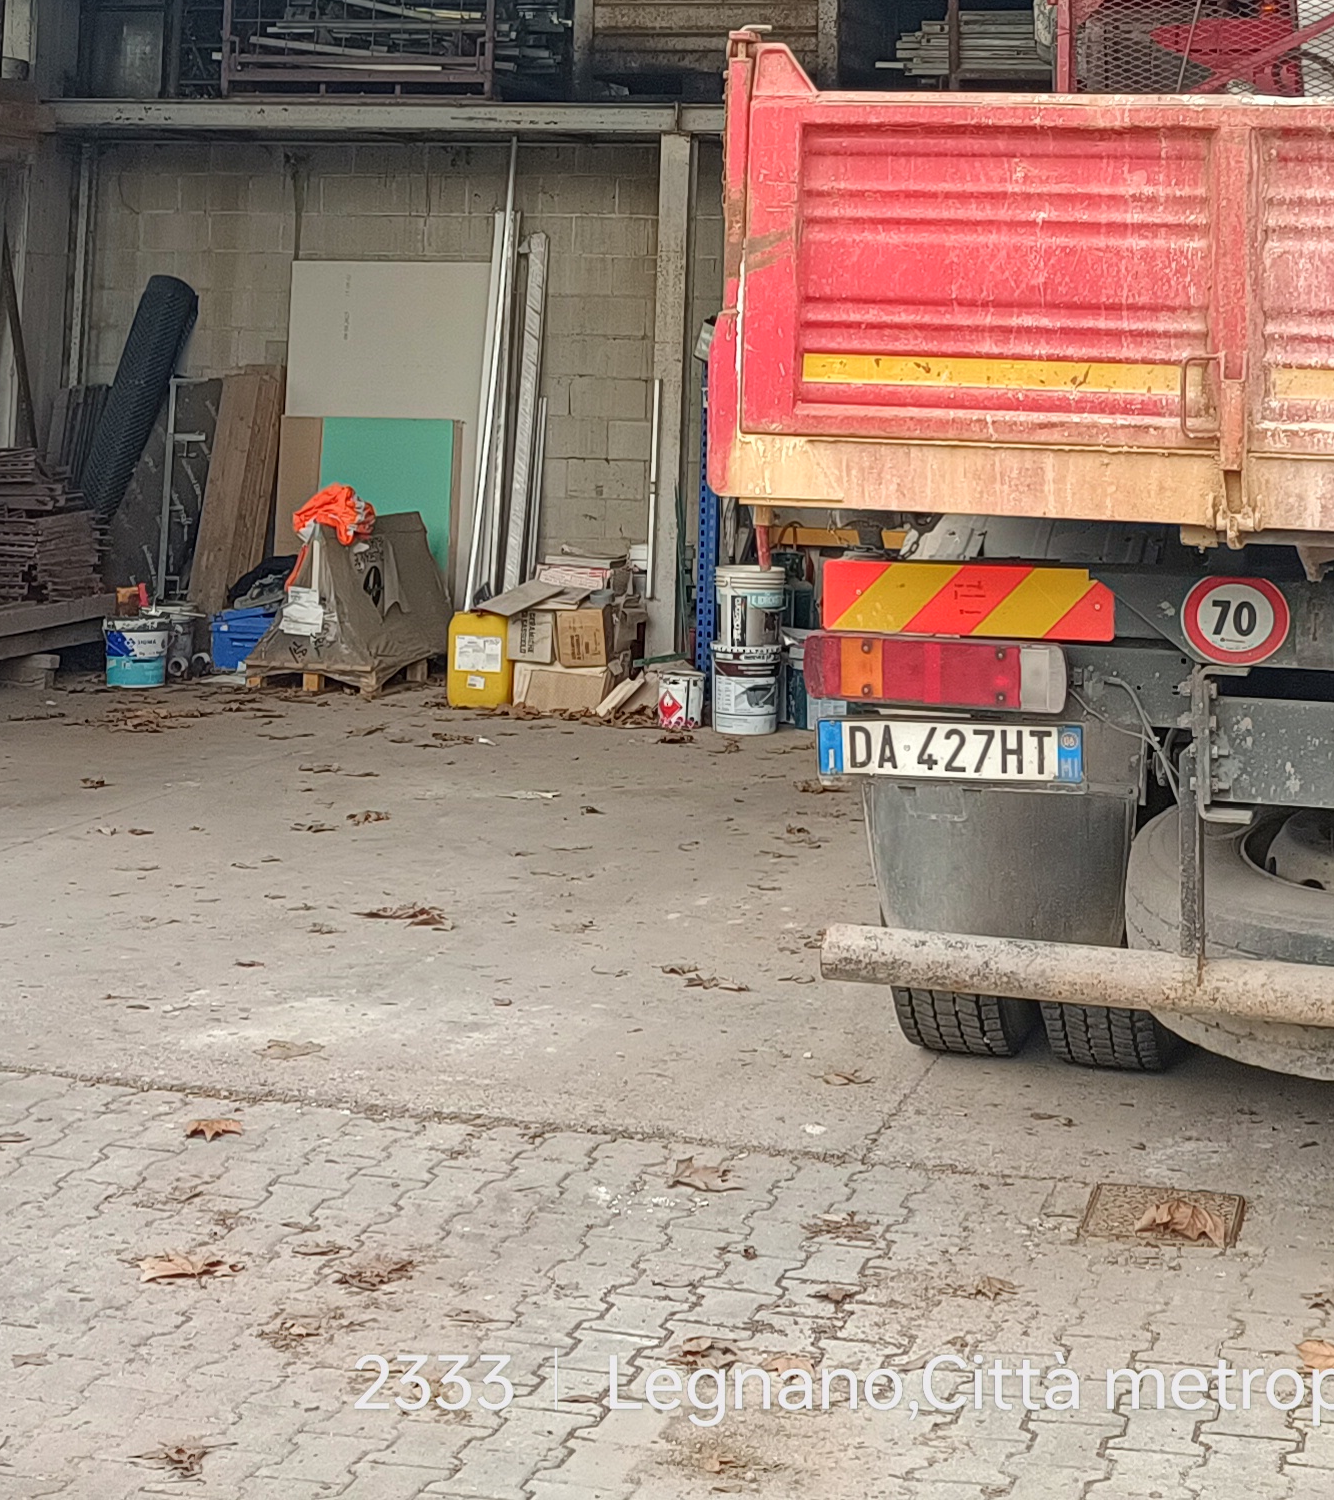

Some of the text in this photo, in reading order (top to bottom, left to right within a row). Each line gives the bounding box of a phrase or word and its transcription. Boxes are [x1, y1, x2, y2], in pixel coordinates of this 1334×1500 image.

[1212, 600, 1257, 637] 70
[849, 724, 1052, 775] DA 427HT
